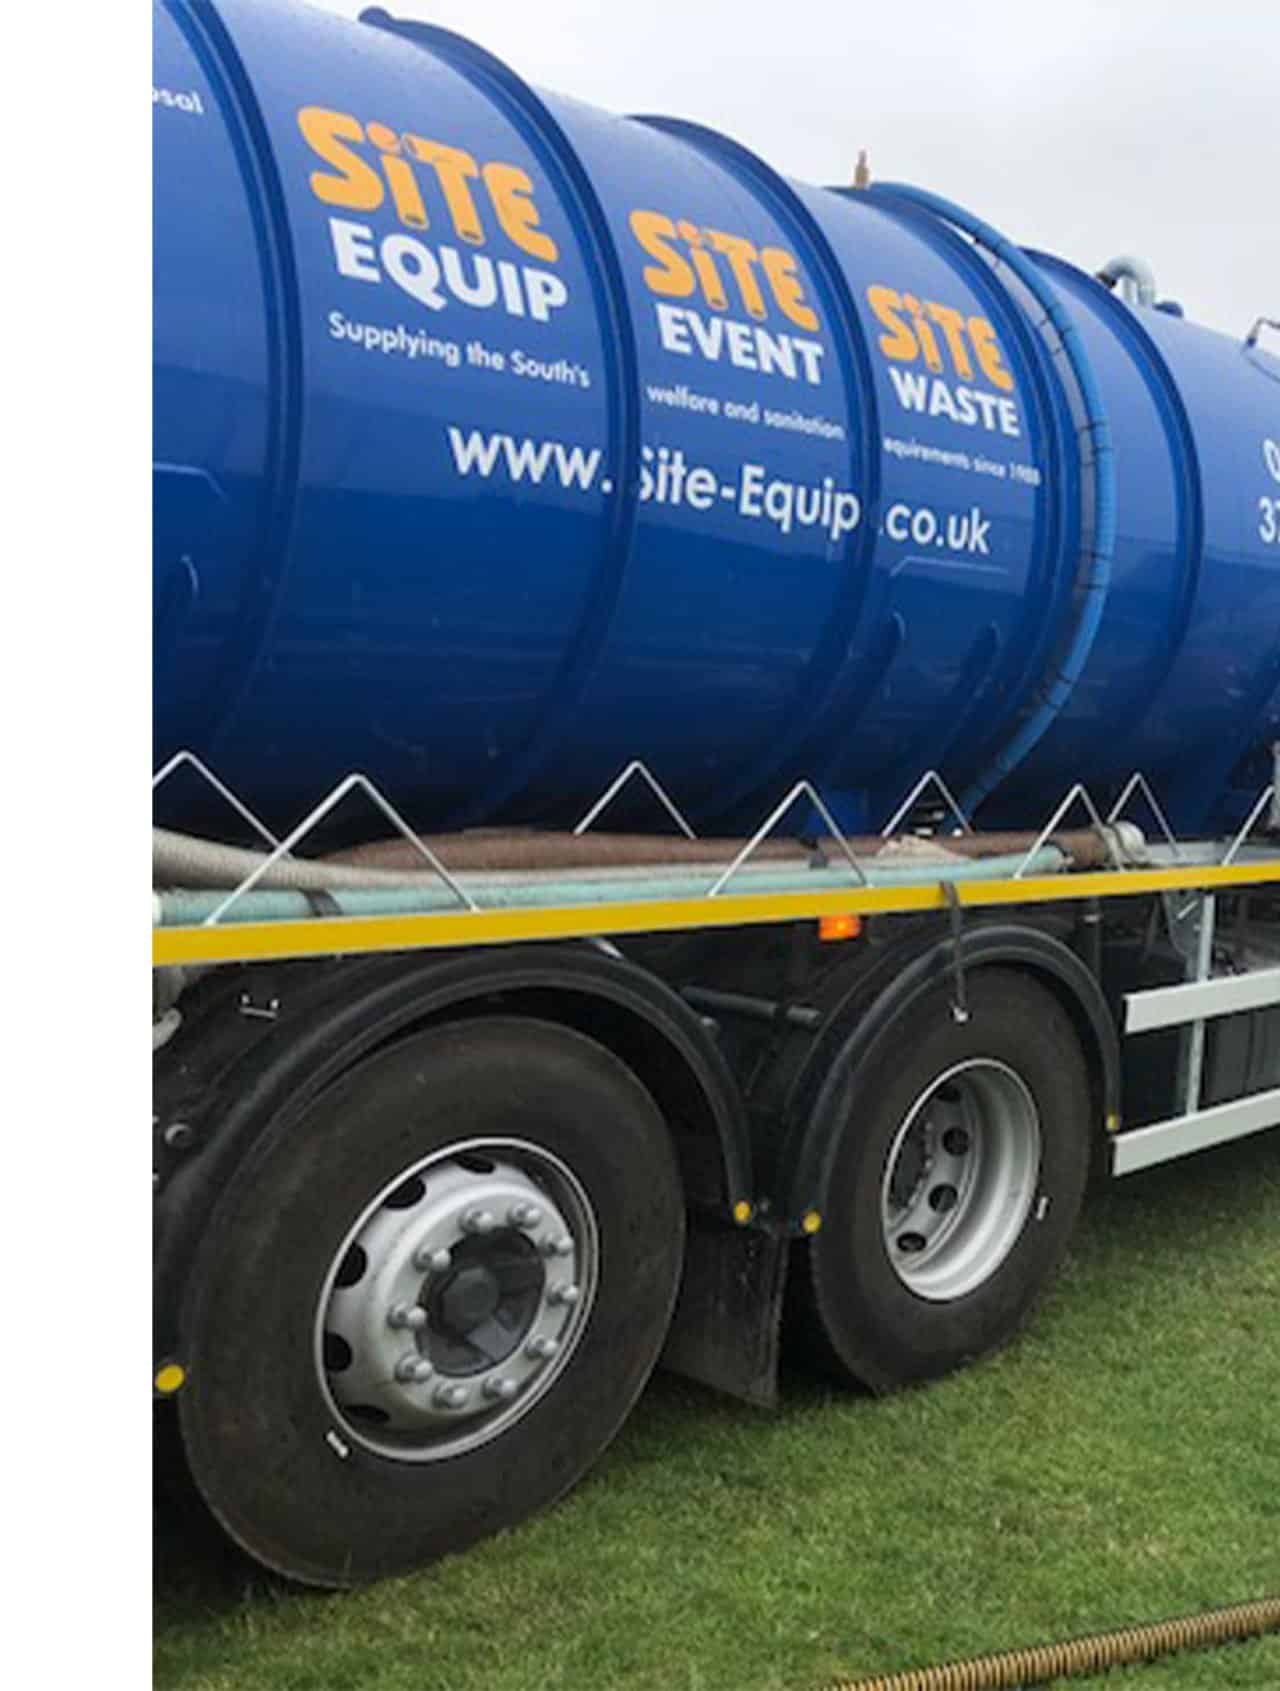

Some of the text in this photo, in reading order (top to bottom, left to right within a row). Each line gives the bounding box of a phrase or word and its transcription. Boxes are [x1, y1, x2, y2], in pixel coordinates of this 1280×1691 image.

[328, 217, 568, 321] EQUIP
[656, 302, 824, 385] EVENT
[328, 311, 461, 367] Supplying
[466, 341, 504, 370] the
[511, 351, 591, 388] South's
[646, 386, 719, 414] welfare
[724, 402, 760, 423] and
[764, 409, 846, 441] sanitation
[882, 436, 969, 471] equirements
[974, 455, 1005, 479] since
[889, 366, 1020, 438] WASTE
